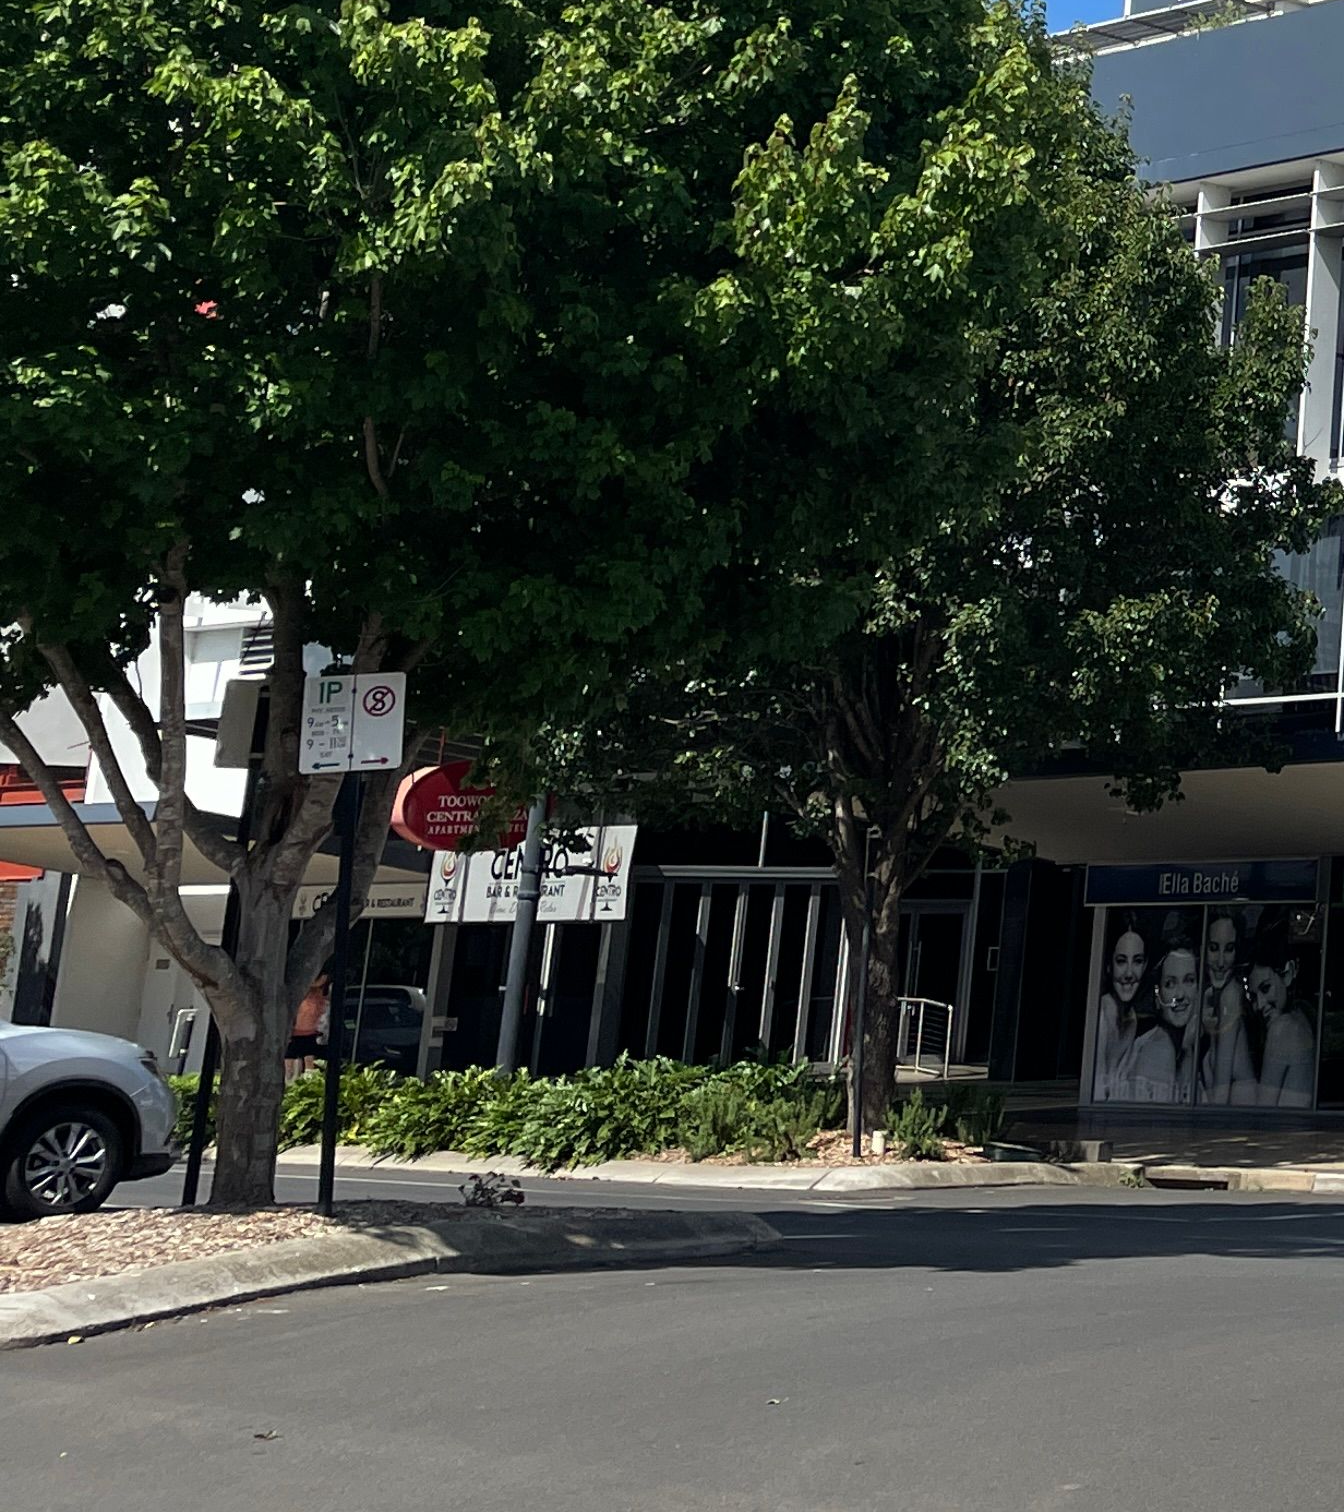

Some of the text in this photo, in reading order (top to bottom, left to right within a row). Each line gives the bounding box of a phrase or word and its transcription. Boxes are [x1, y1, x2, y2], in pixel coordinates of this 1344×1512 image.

[319, 681, 343, 705] 1P
[427, 811, 484, 823] CENTRA
[491, 845, 569, 878] CENRO
[486, 886, 502, 898] BAR
[513, 885, 565, 897] RRANT
[1161, 871, 1239, 894] Ella Baché
